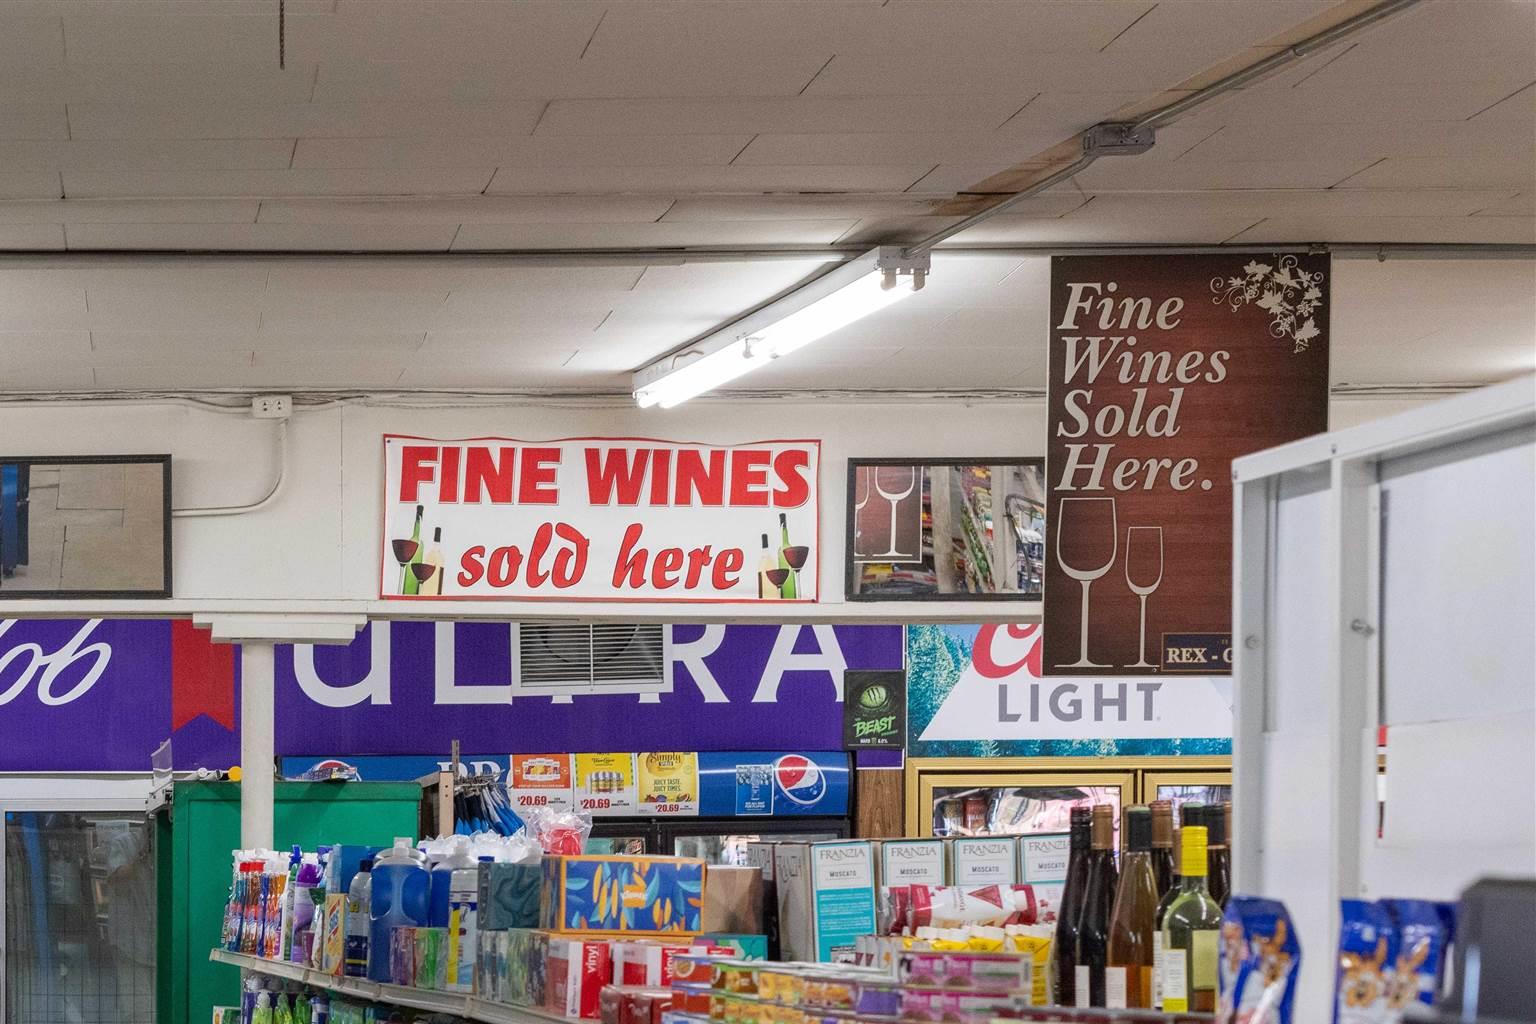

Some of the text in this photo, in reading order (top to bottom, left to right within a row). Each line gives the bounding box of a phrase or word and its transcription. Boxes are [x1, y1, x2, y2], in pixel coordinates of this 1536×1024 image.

[1057, 282, 1184, 331] Fine
[1061, 335, 1230, 385] Wines
[1056, 388, 1184, 439] Sold
[399, 445, 811, 509] FINE WINES
[1054, 443, 1213, 492] Here.
[456, 522, 745, 590] sold here
[1166, 647, 1207, 663] REX
[999, 683, 1163, 723] LIGHT
[853, 716, 896, 737] BEAST
[820, 849, 865, 861] FRANZIA
[891, 847, 937, 858] FRANZIA
[963, 844, 1008, 856] FRANZIA
[586, 945, 599, 974] vinyl
